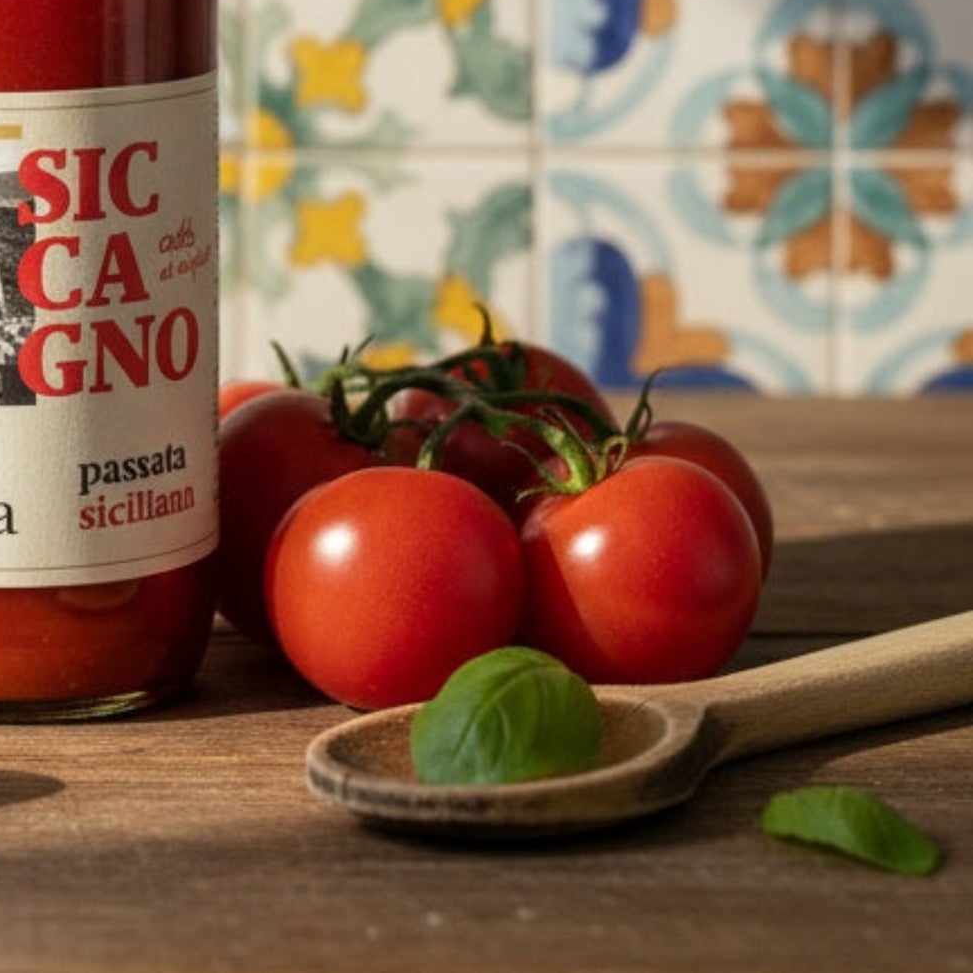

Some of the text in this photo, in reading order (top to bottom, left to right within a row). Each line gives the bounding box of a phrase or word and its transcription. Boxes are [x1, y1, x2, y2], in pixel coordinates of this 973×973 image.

[17, 141, 159, 226] SIC
[17, 232, 150, 311] CA
[17, 306, 199, 397] GNO
[78, 443, 186, 496] passata
